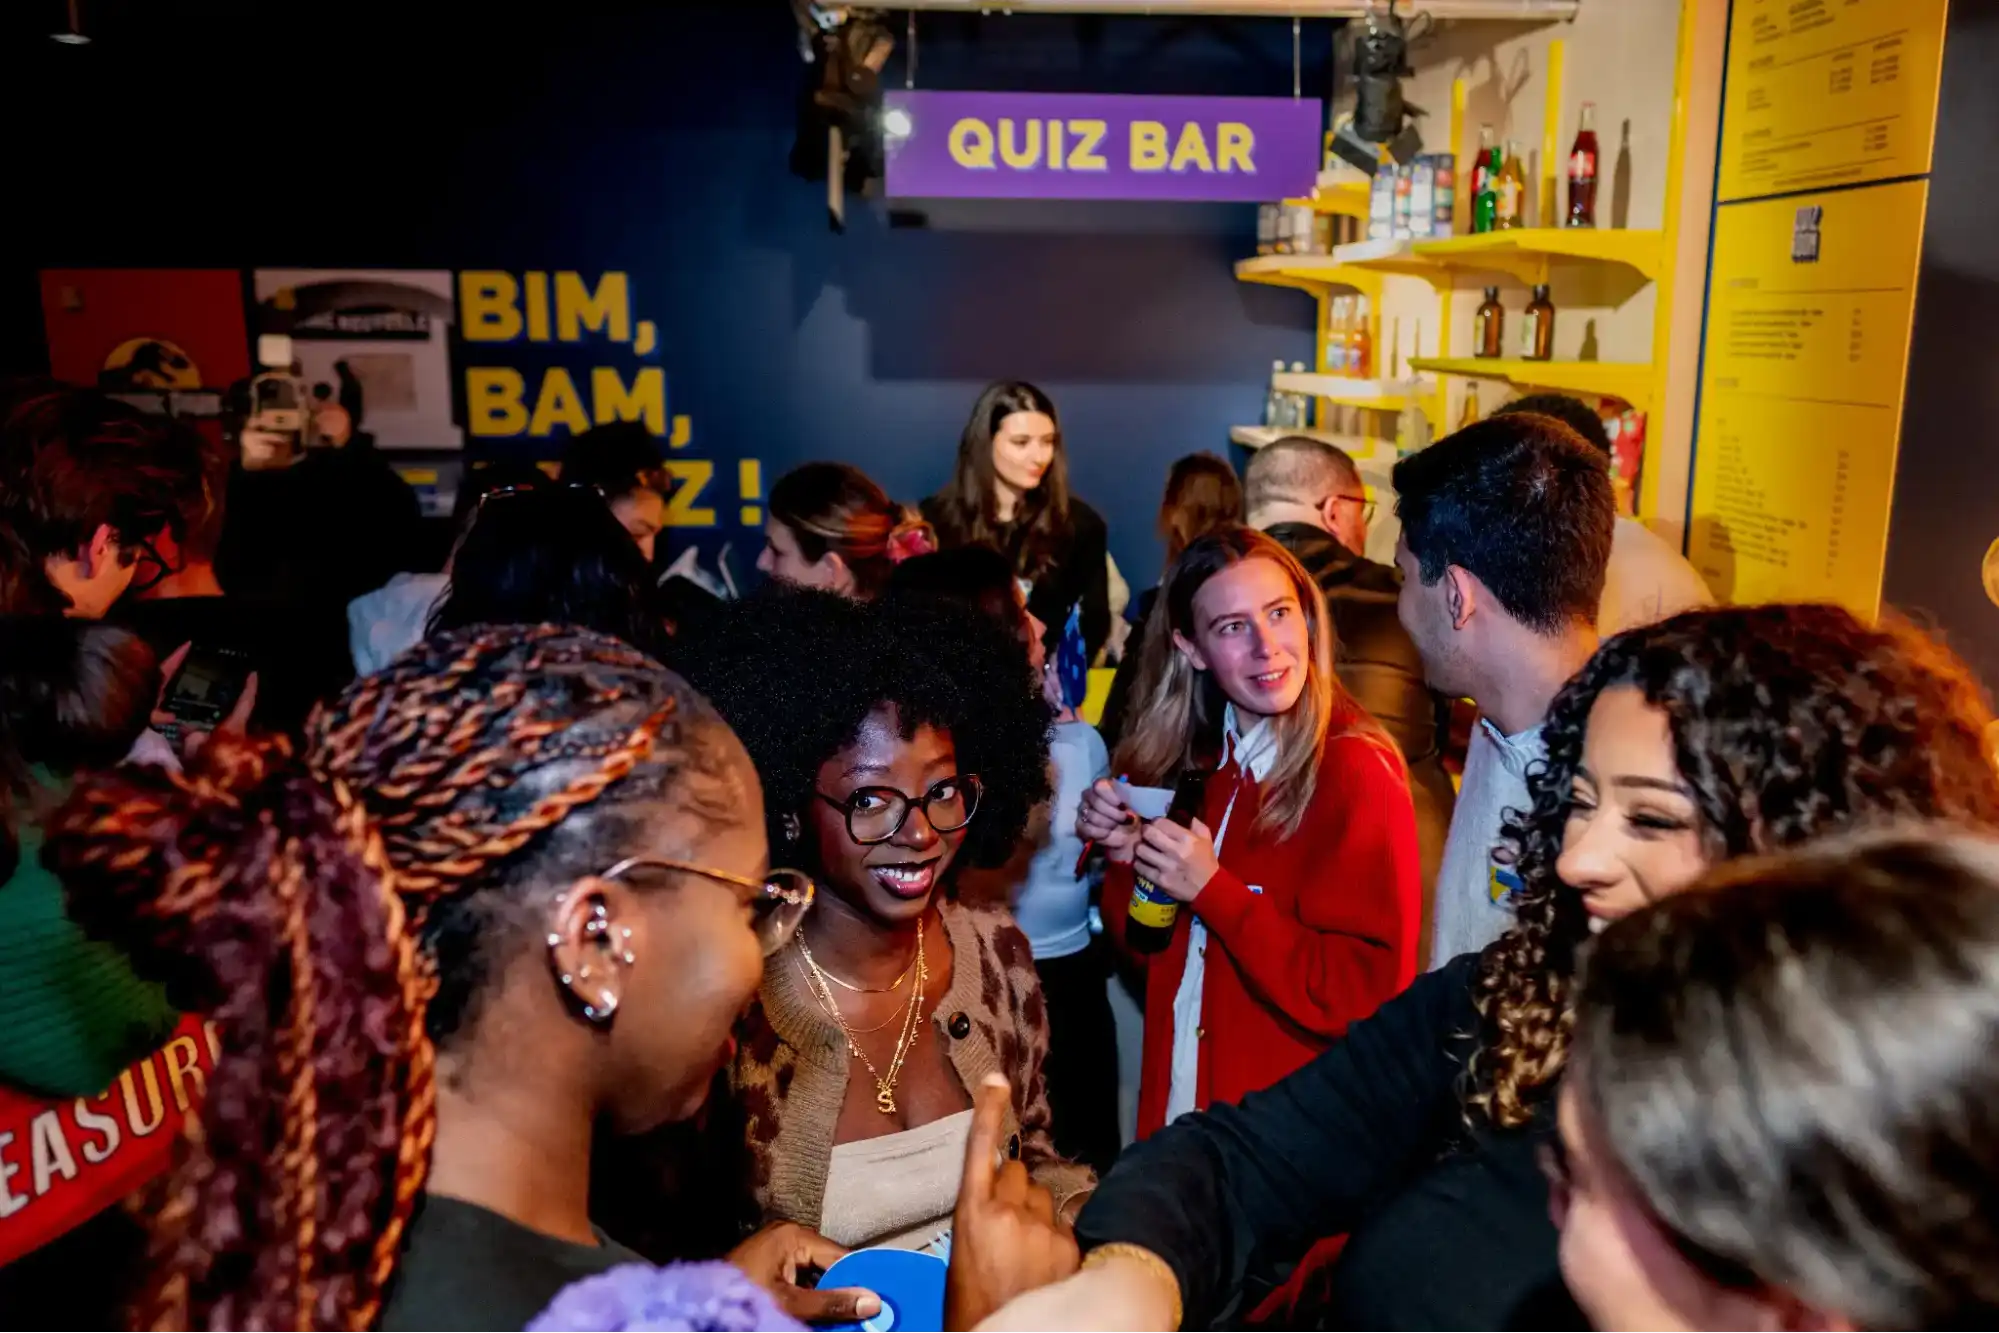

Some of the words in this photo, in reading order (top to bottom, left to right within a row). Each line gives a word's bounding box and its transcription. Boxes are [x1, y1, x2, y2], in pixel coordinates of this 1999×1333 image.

[948, 117, 1108, 171] QUIZ
[1129, 121, 1257, 172] BAR
[459, 271, 657, 355] BIM,
[466, 367, 692, 448] BAM,
